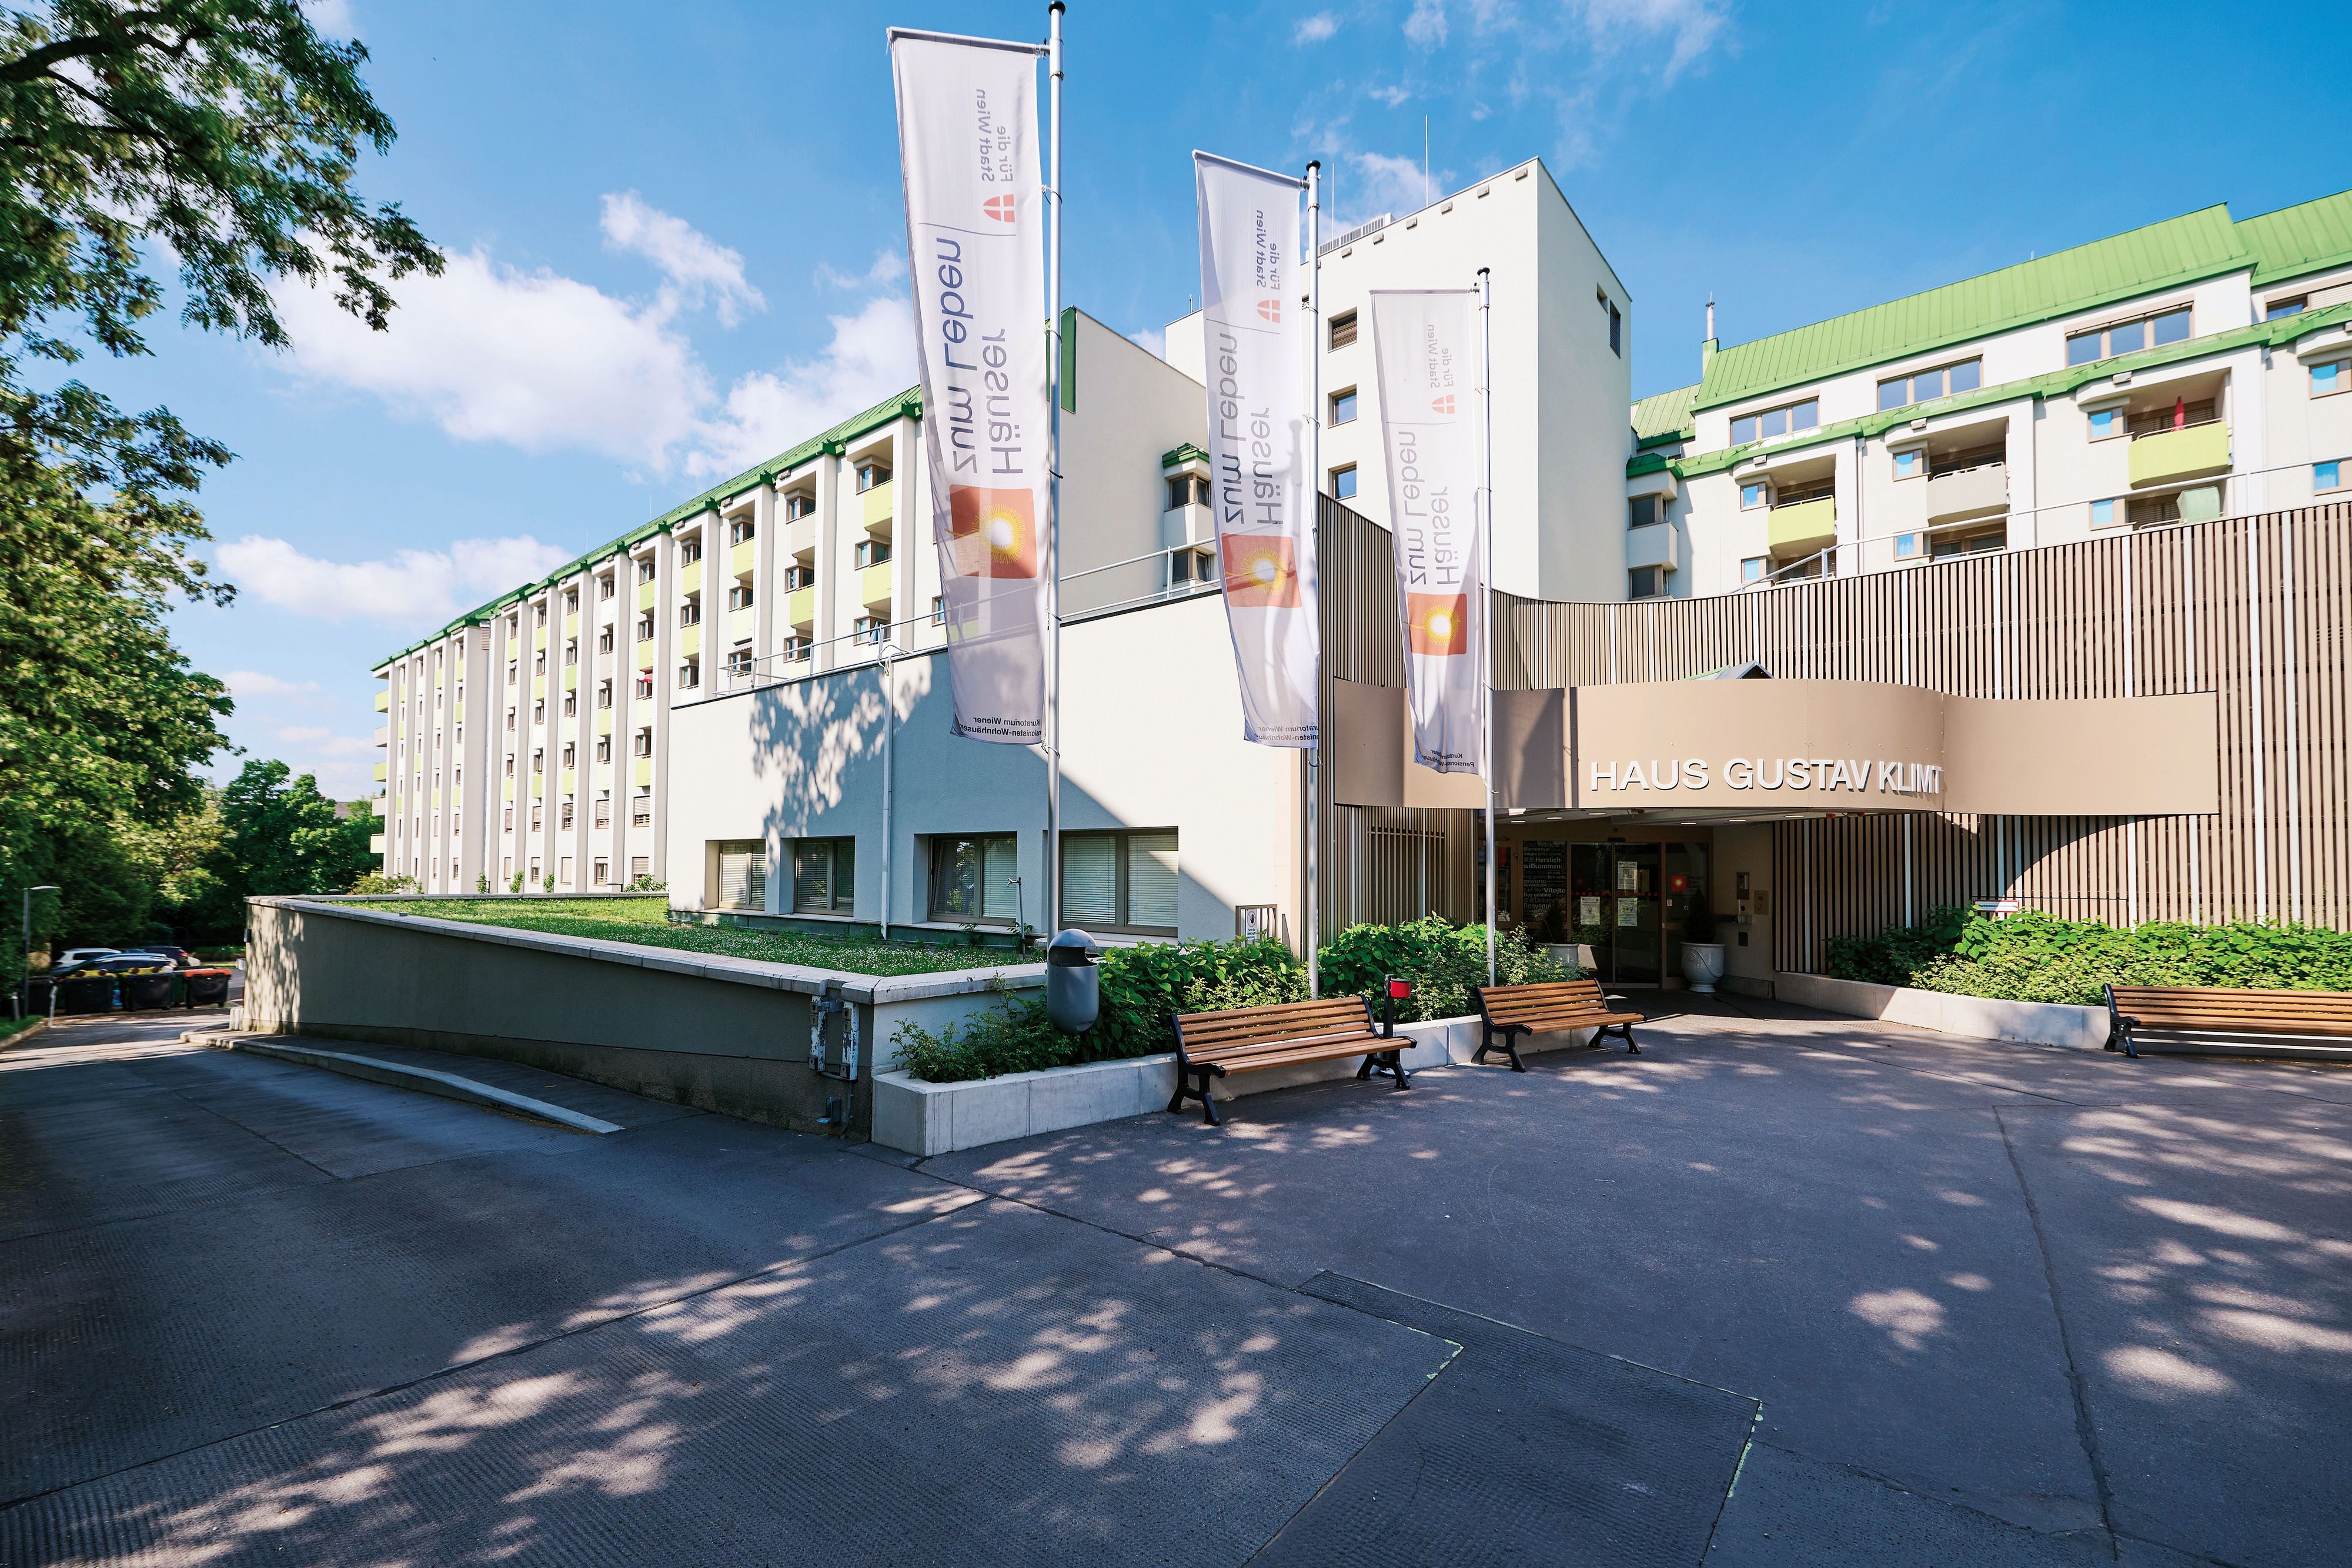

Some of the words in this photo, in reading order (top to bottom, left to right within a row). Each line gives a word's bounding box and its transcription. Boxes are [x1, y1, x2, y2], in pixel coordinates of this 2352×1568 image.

[1591, 758, 1710, 791] HAUS
[1723, 758, 1872, 793] GUSTAV
[1879, 761, 1943, 794] KLIMT
